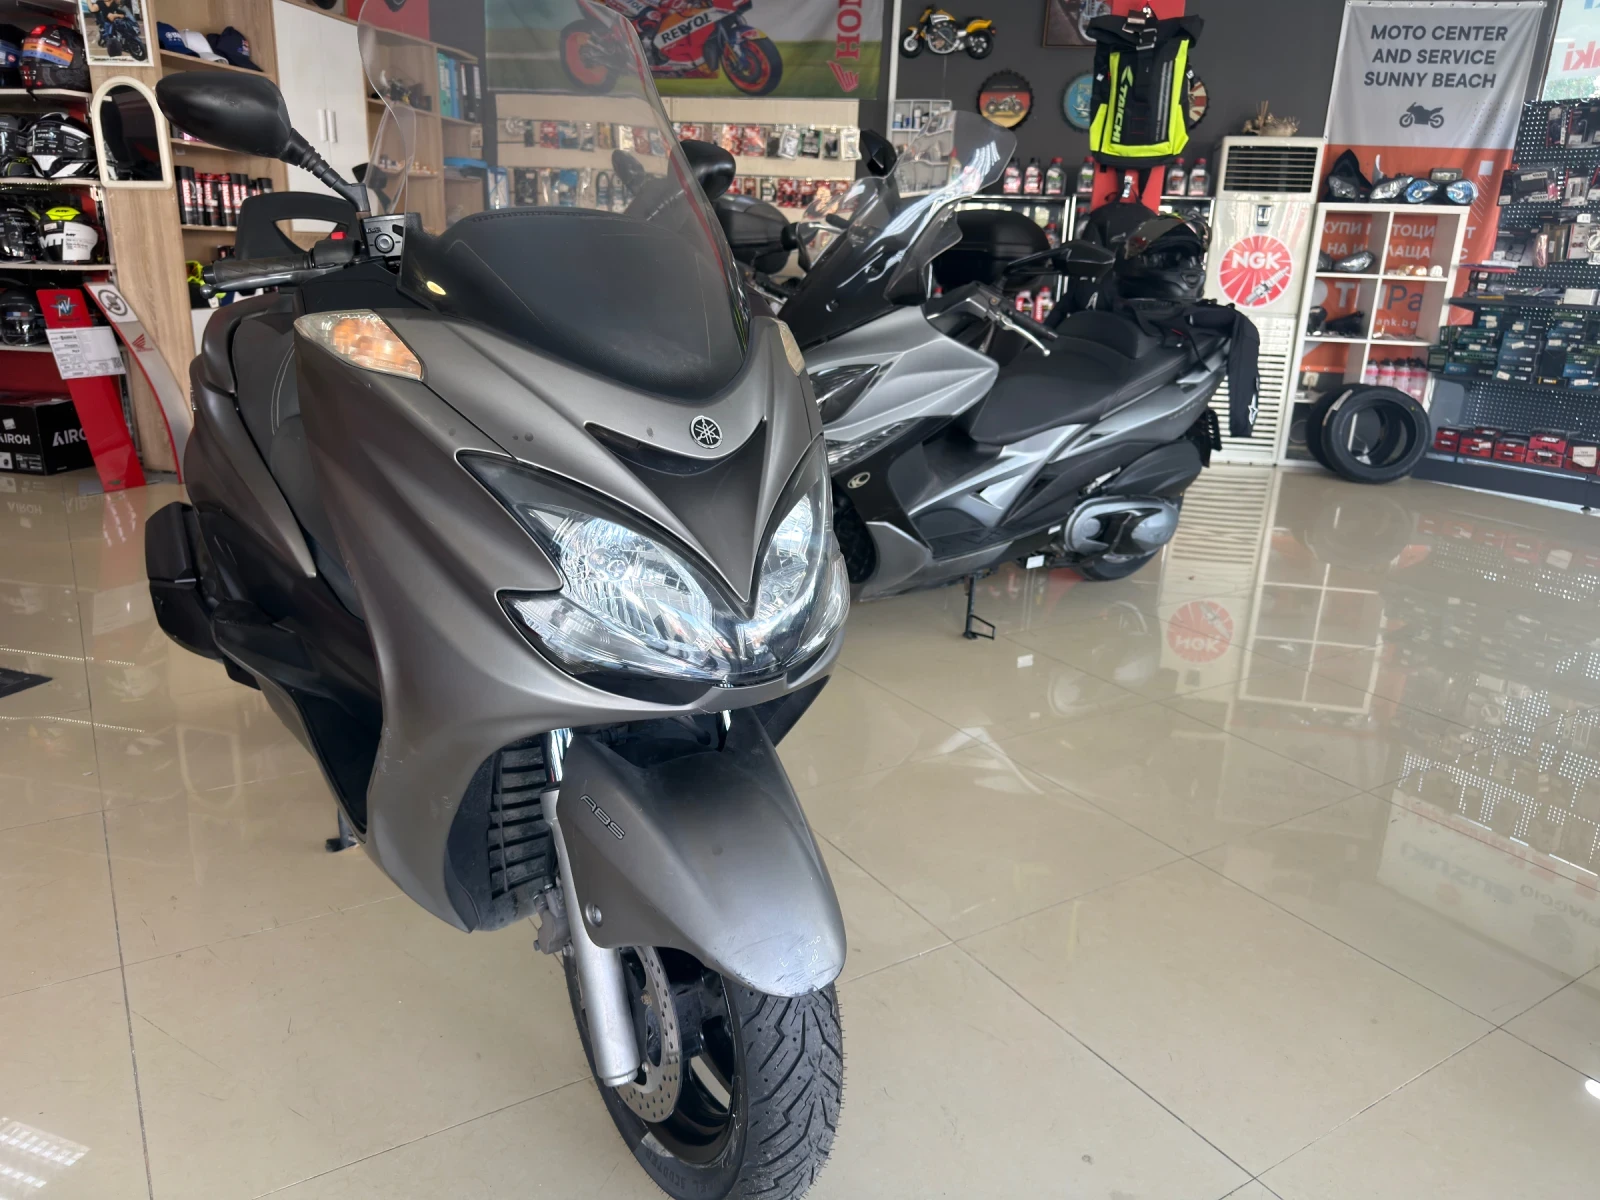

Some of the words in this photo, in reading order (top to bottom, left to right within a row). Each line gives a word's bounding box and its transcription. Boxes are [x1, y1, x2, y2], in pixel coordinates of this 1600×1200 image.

[1371, 25, 1426, 40] MOTO
[1431, 25, 1508, 41] CENTER
[1372, 49, 1412, 64] AND
[1416, 49, 1497, 65] SERVICE
[1364, 71, 1428, 87] SUNNY
[1432, 73, 1497, 88] BEACH
[1111, 86, 1129, 144] TAICHI
[1327, 241, 1348, 255] НА
[1231, 251, 1283, 270] NGK
[579, 794, 626, 840] ABS
